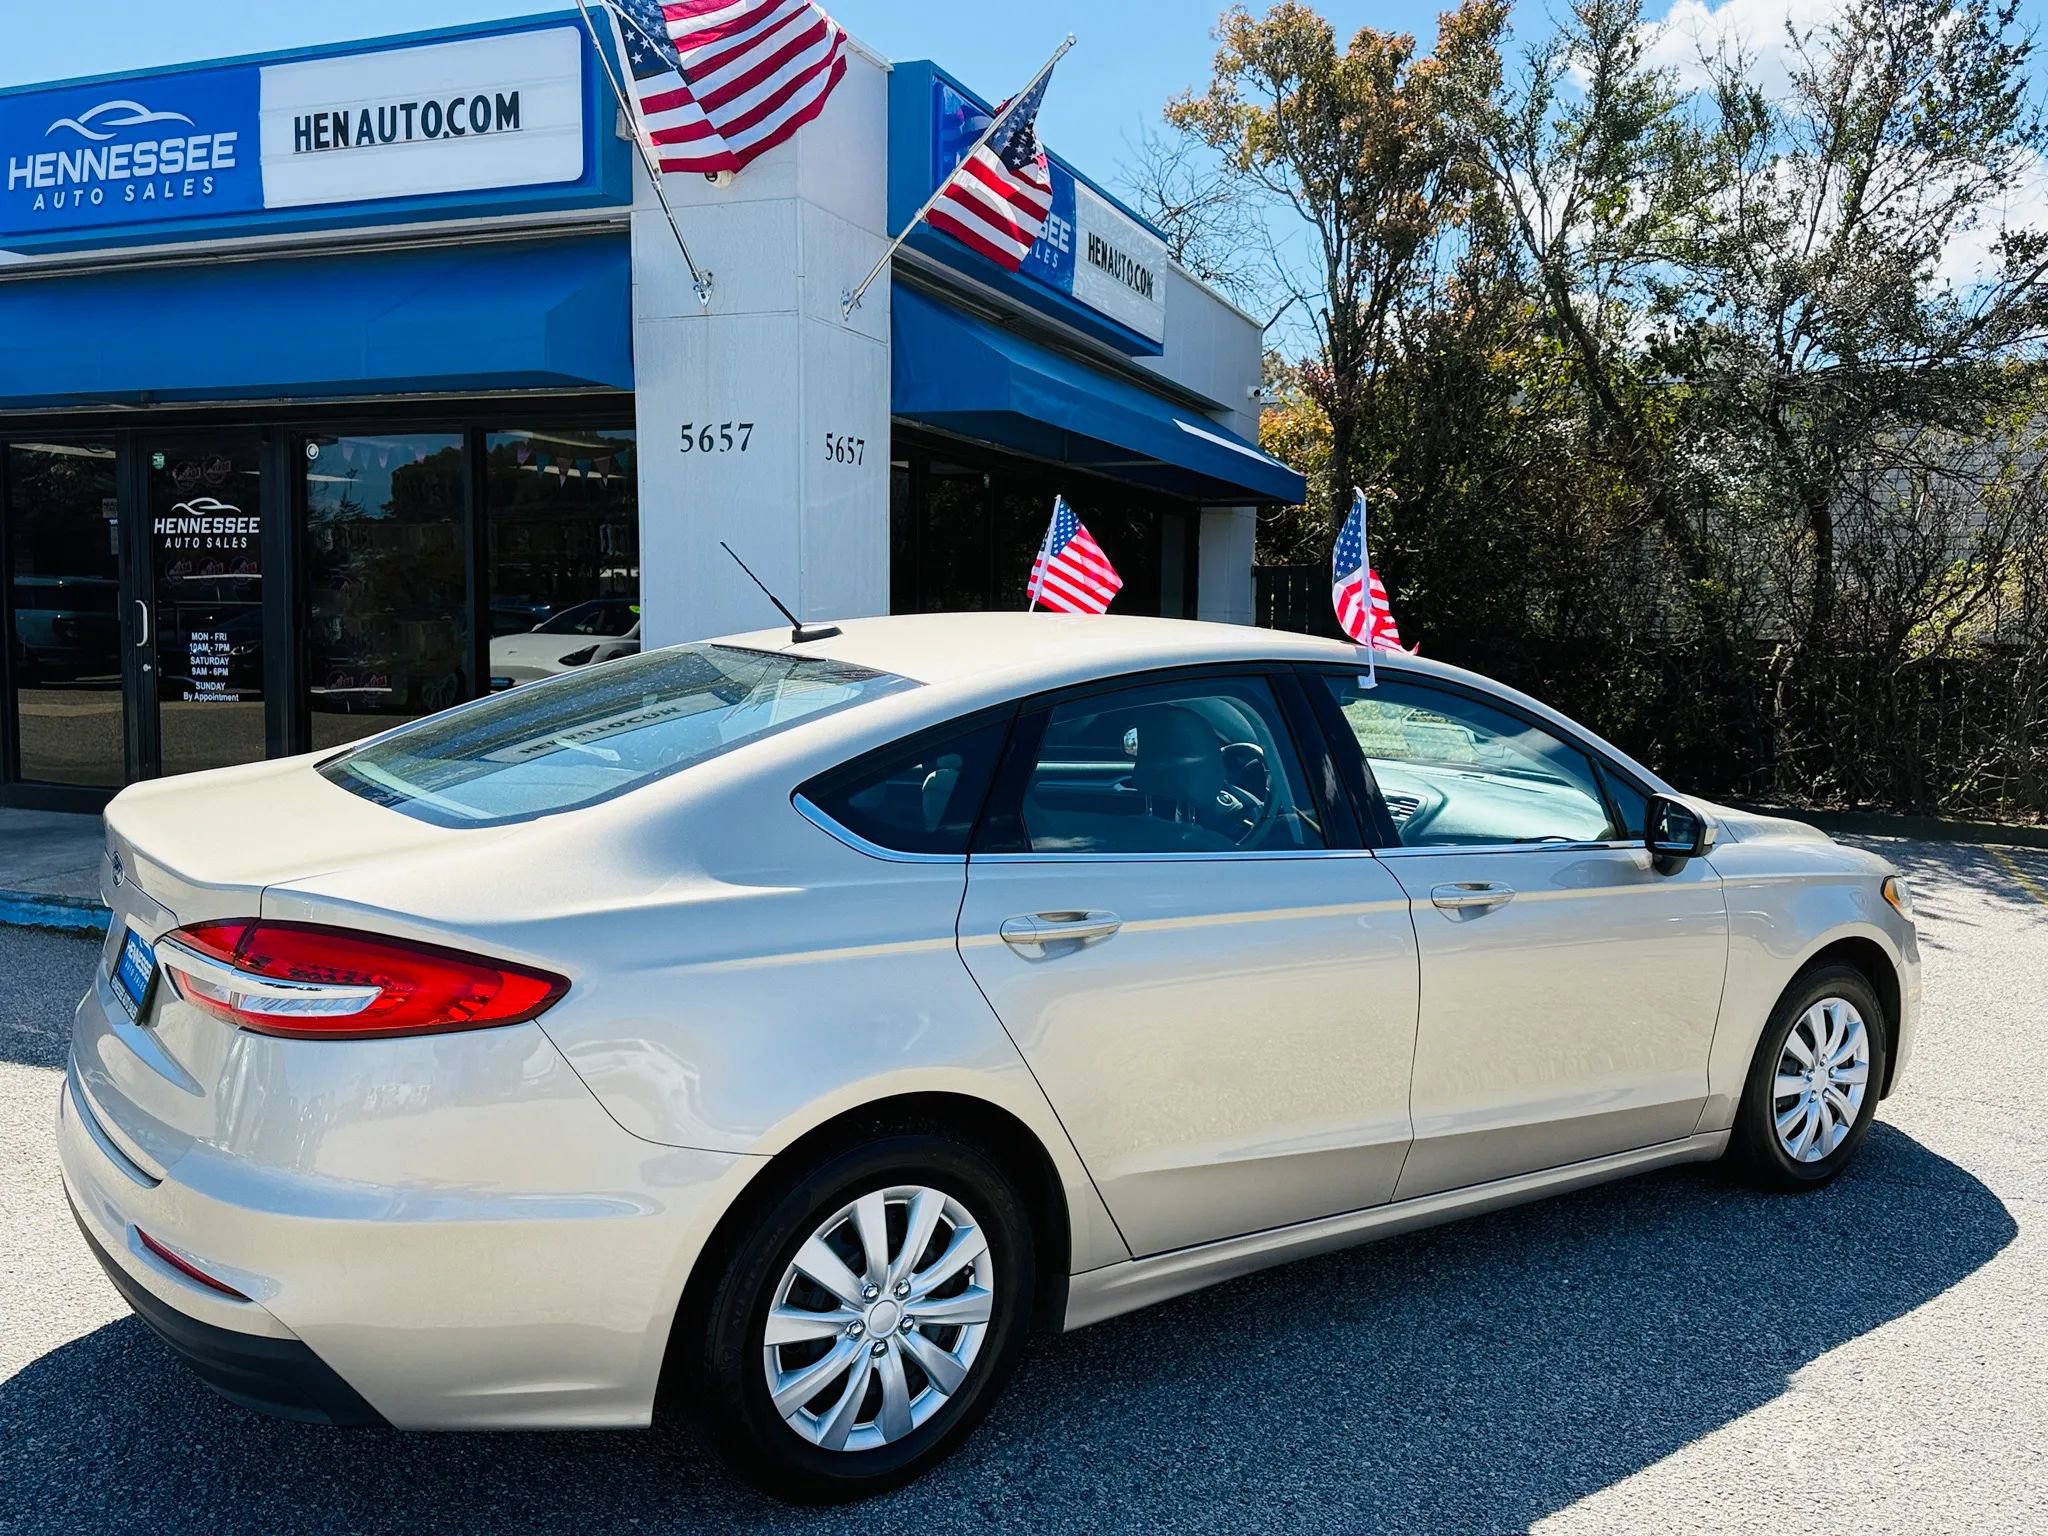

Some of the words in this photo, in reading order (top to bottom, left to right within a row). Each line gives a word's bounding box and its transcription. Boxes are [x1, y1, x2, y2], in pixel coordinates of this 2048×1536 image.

[8, 131, 238, 191] HENNESSEE
[33, 188, 104, 211] AUTO
[124, 176, 215, 200] SALES
[680, 420, 754, 453] 5657
[825, 432, 865, 466] 5657
[154, 517, 260, 534] HENNESSEE
[165, 537, 200, 549] AUTO
[206, 536, 248, 549] SALES
[191, 632, 209, 641] MON
[215, 632, 227, 641] FRI
[215, 643, 230, 651] 7PM
[190, 656, 230, 665] SATURDAY
[191, 667, 208, 676] 9AM
[214, 667, 229, 676] 6PM
[195, 681, 226, 690] SUNDAY
[183, 691, 193, 703] By
[194, 691, 240, 702] Appointment
